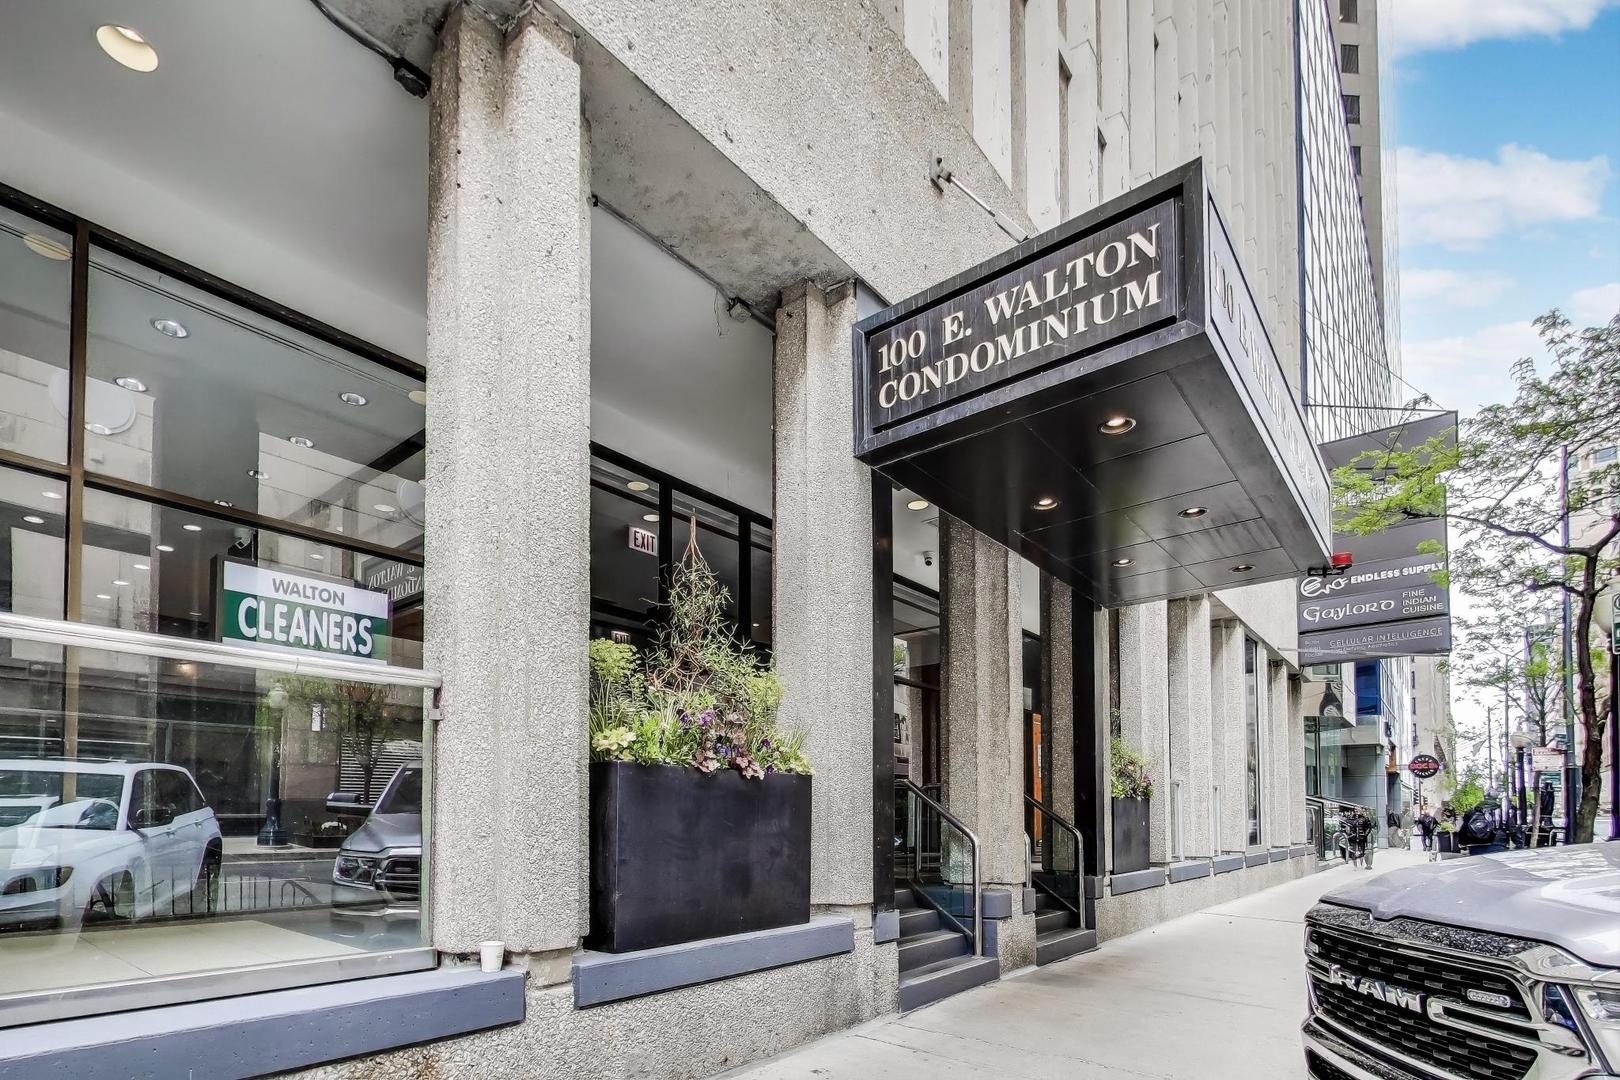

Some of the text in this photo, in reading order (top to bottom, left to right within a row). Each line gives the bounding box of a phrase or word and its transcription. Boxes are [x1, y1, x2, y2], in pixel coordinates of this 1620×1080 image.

[878, 222, 1160, 373] 100 E. WALTON
[878, 271, 1162, 409] CONDOMINIUM
[633, 531, 656, 553] EXIT
[1350, 562, 1445, 584] ENDLESS SUPPLY
[272, 577, 345, 606] WALTON
[1402, 589, 1425, 597] FINE
[1402, 596, 1437, 606] INDIAN
[1402, 603, 1445, 614] CUISINE
[238, 597, 373, 655] CLEANERS
[1329, 627, 1443, 648] CELLULAR INTELLIGENCE
[1331, 964, 1426, 1013] RAM
